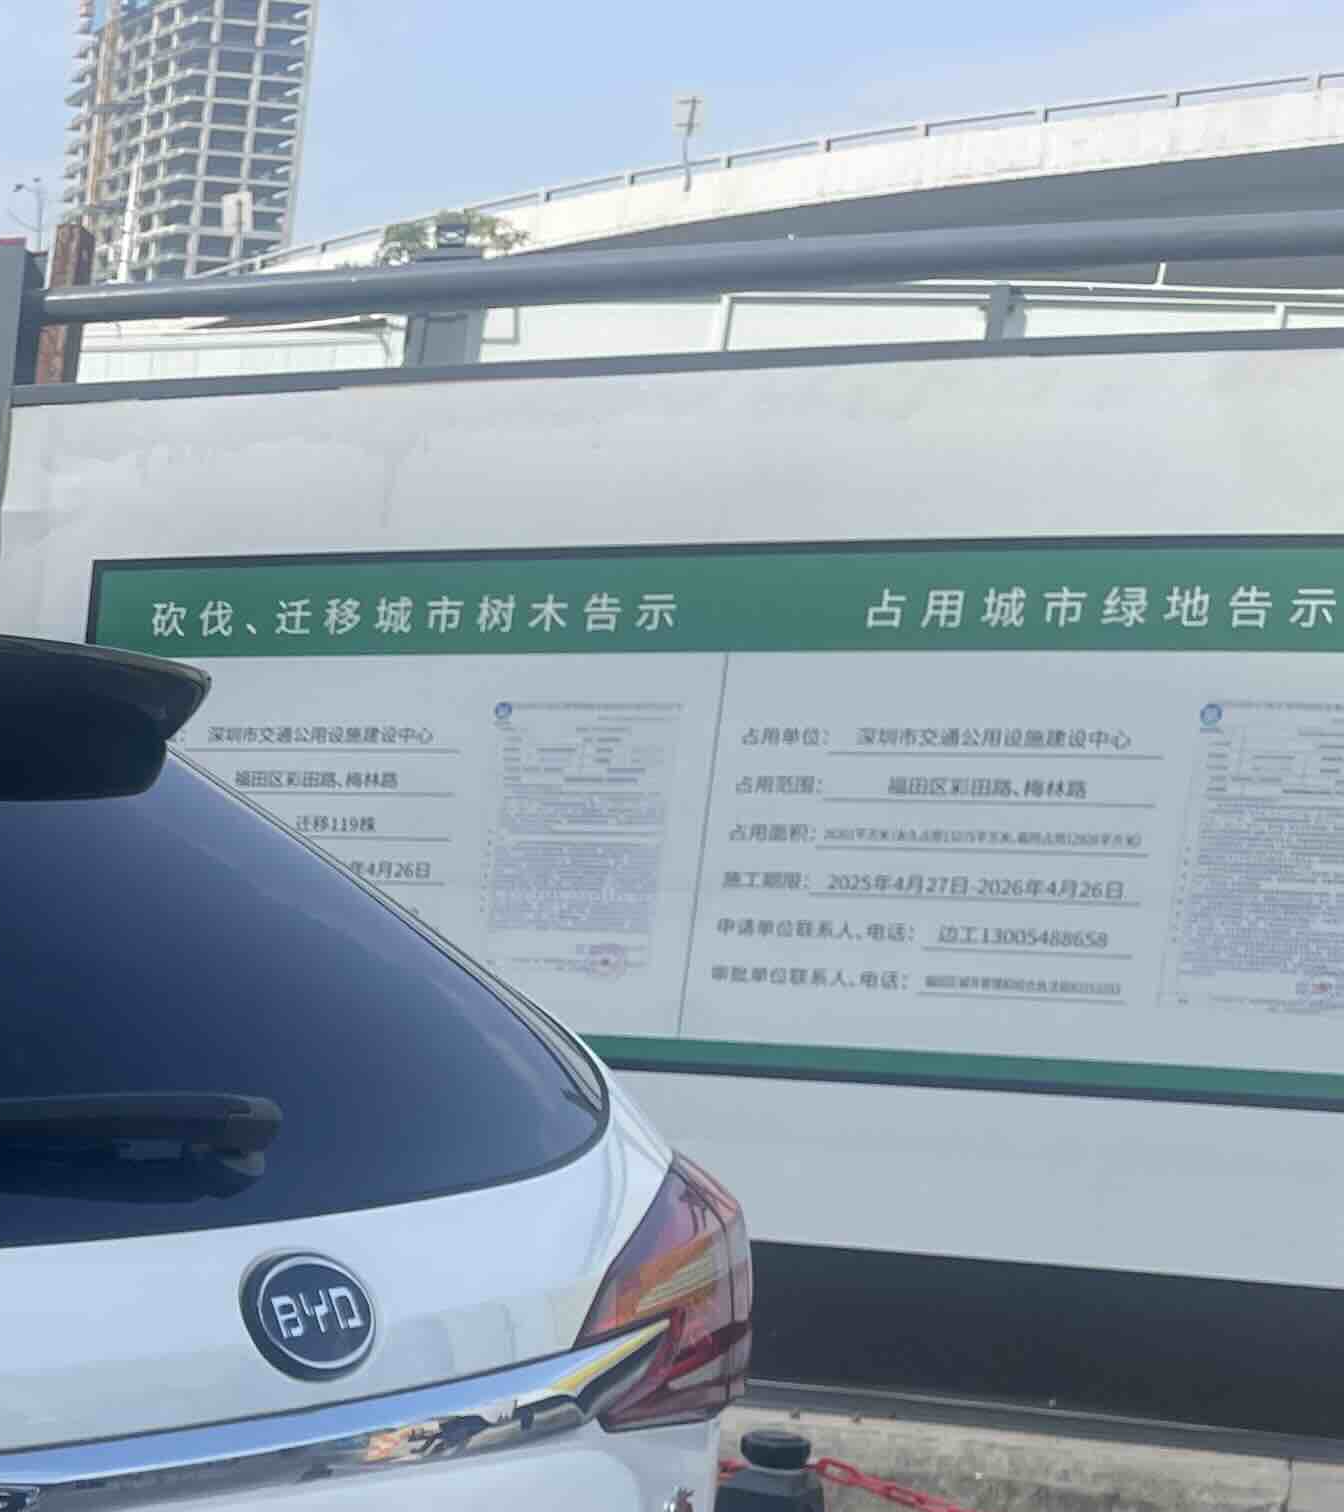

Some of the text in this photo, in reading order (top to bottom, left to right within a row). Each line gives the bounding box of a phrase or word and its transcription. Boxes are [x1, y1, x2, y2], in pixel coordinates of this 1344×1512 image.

[152, 592, 678, 637] 砍伐、迁移城市树木告示
[866, 586, 1338, 629] 占用城市绿地告示
[207, 724, 434, 745] 深圳市交通公用设施建设中心
[856, 727, 1132, 750] 深圳市交通公用设施建设中心
[270, 1286, 363, 1339] BYD
